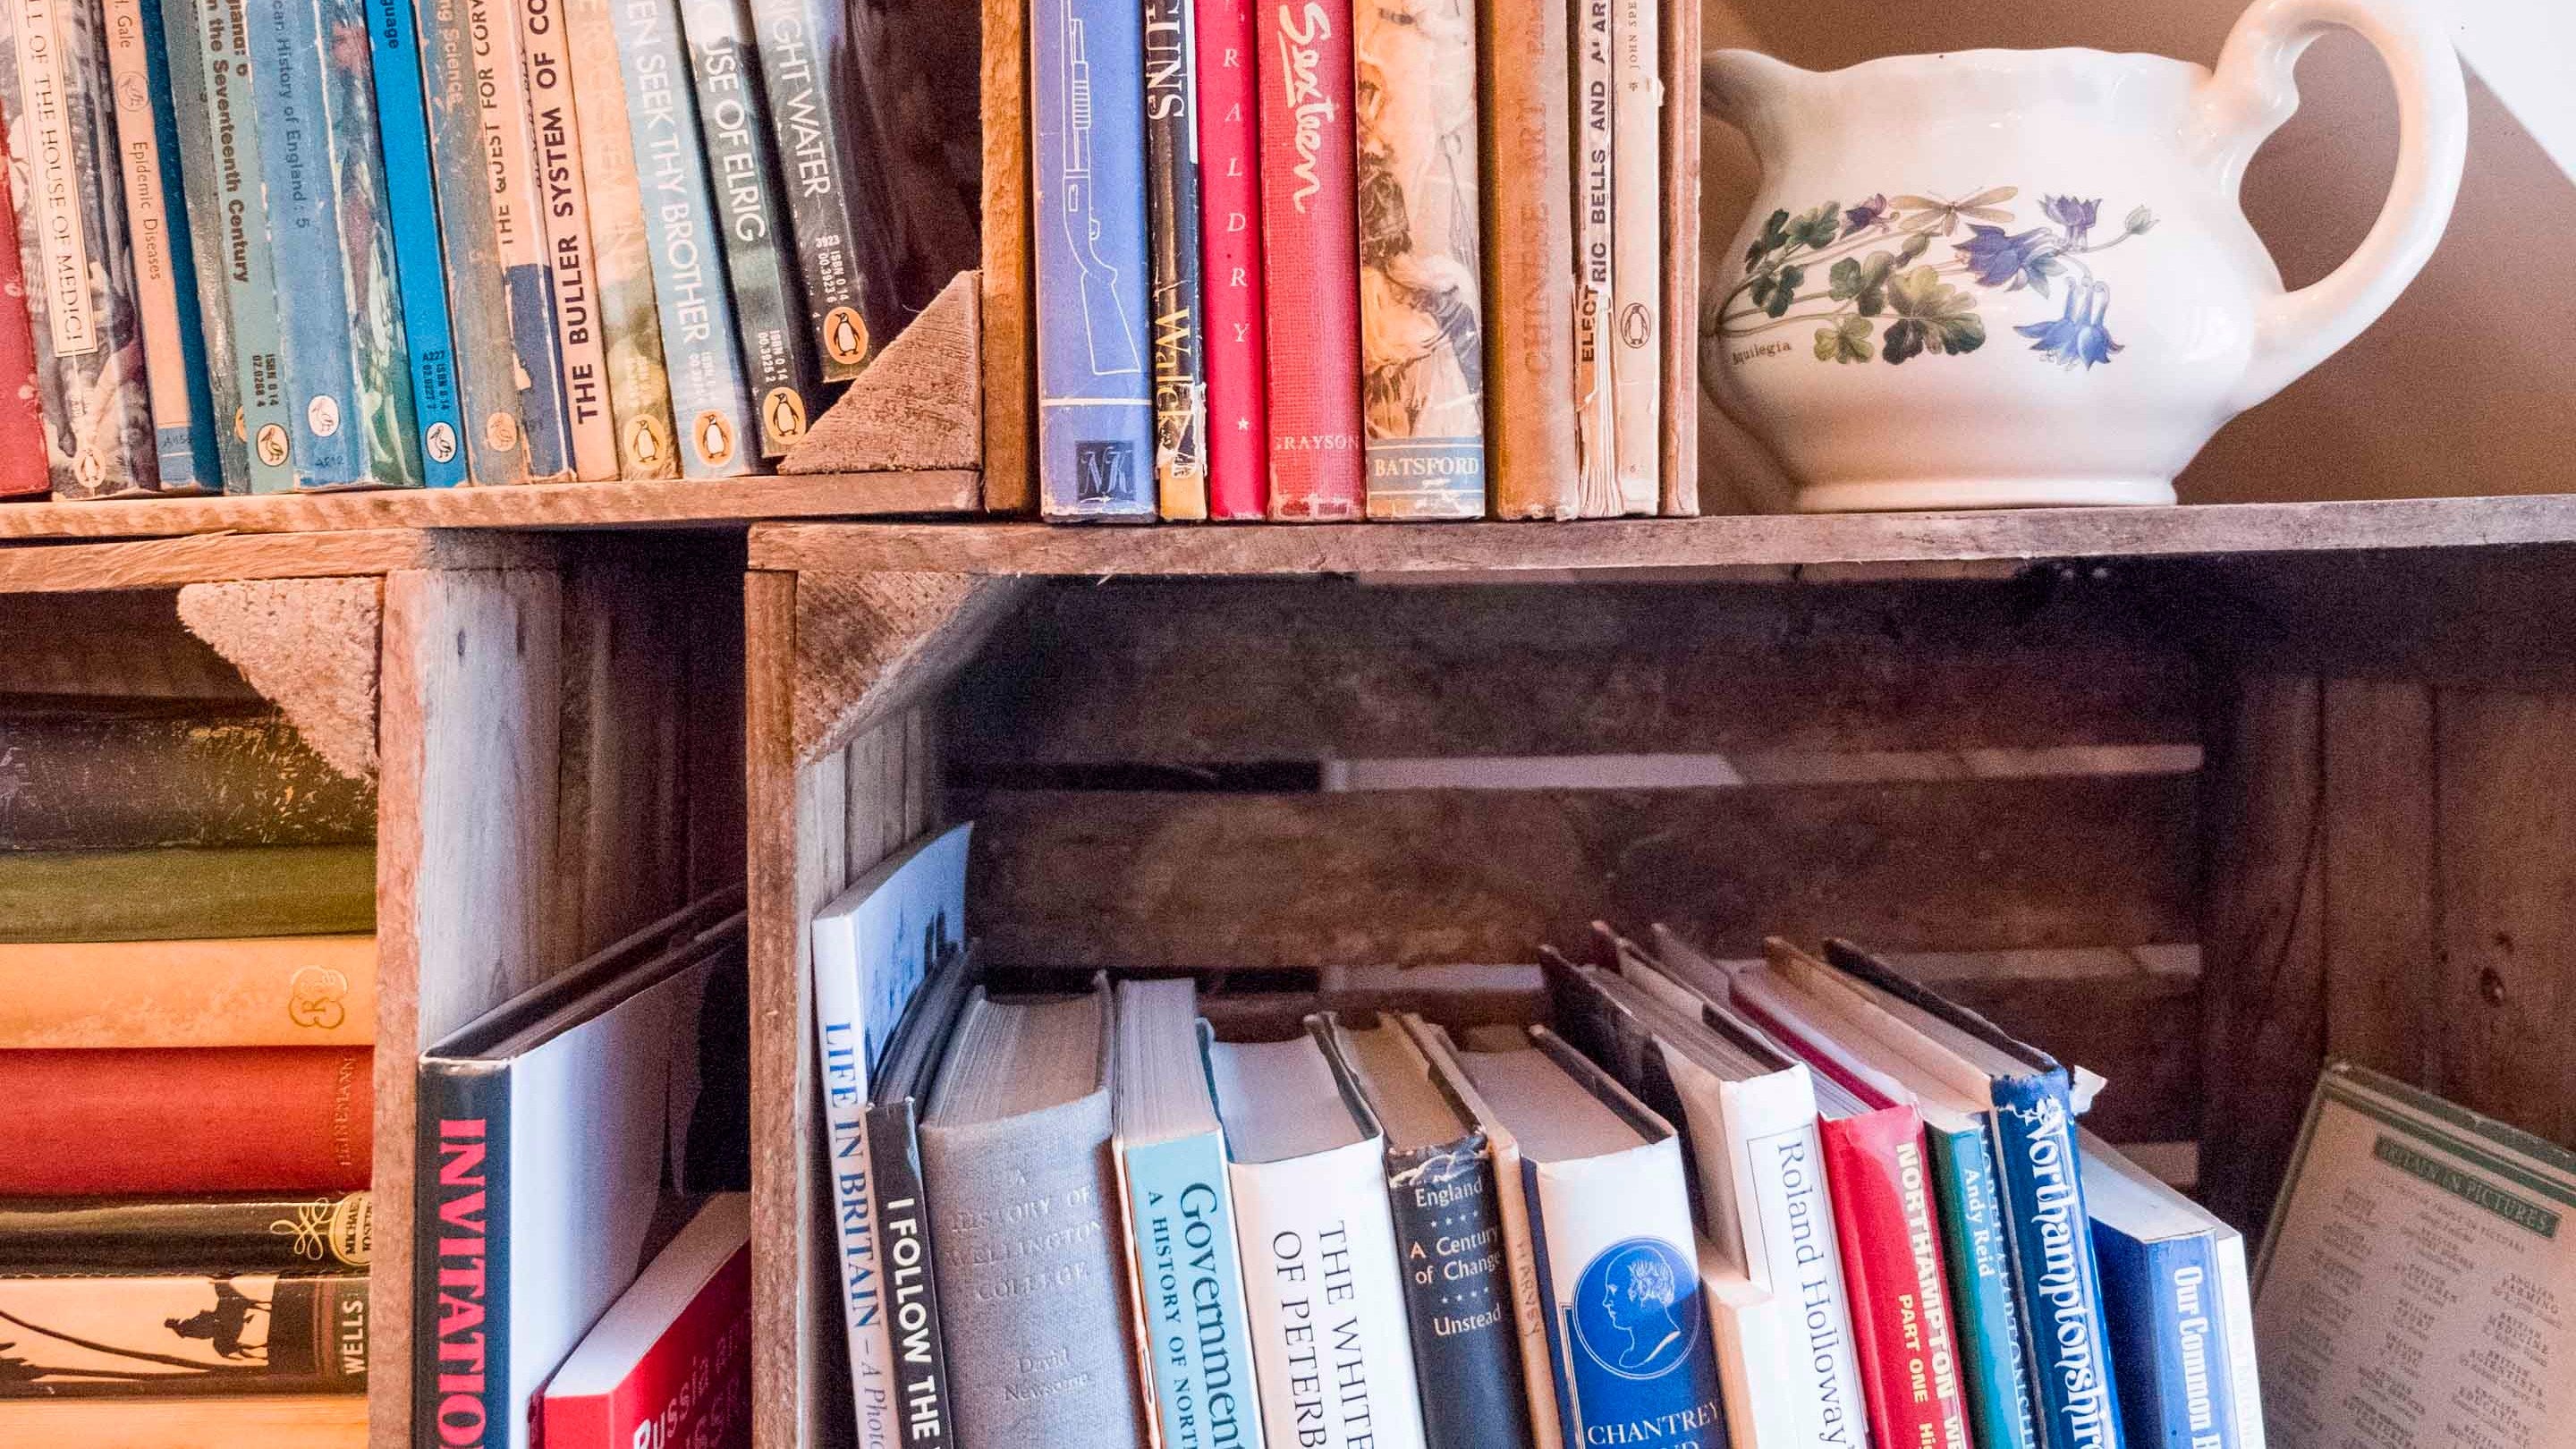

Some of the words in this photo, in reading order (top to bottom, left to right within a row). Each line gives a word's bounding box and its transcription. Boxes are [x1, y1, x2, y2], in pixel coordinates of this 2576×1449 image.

[30, 35, 47, 64] OF
[117, 14, 134, 48] Gale
[208, 18, 225, 52] the
[1629, 34, 1640, 70] JOHN
[275, 38, 292, 99] History
[284, 106, 300, 124] of
[442, 27, 464, 105] Science
[478, 67, 498, 109] FOR
[534, 52, 557, 89] OF
[636, 54, 676, 129] SEEK
[35, 78, 56, 123] THE
[213, 59, 242, 192] Seventeenth
[715, 98, 750, 147] OF
[1590, 80, 1606, 131] AND
[41, 129, 66, 208] HOUSE
[484, 122, 508, 194] QUEST
[541, 106, 573, 218] SYSTEM
[648, 133, 687, 193] THY
[787, 87, 831, 198] WATER
[130, 141, 152, 209] Epidemic
[143, 218, 161, 281] Diseases
[723, 152, 766, 242] ELRIG
[1591, 148, 1606, 225] BELLS
[52, 216, 72, 244] OF
[227, 199, 250, 282] Century
[56, 254, 82, 342] MEDICI
[557, 234, 589, 345] BULLER
[660, 202, 711, 344] BROTHER
[818, 252, 835, 293] 00.3923
[831, 250, 844, 276] ISBN
[838, 288, 850, 301] 14
[265, 353, 276, 379] ISBN
[436, 363, 447, 386] ISBN
[769, 329, 784, 355] ISBN
[777, 369, 789, 381] 14
[269, 394, 279, 406] 14
[572, 363, 598, 425] THE
[1374, 457, 1480, 478] BATSFORD
[826, 1022, 858, 1108] LIFE
[835, 1120, 864, 1158] IN
[887, 1198, 915, 1209] I
[1148, 1191, 1165, 1206] A
[1414, 1177, 1484, 1208] England
[1965, 1167, 1985, 1224] Andy
[2465, 1180, 2552, 1233] PICTURES
[839, 1172, 880, 1328] BRITAIN
[1272, 1230, 1307, 1283] OF
[1318, 1219, 1354, 1305] THE
[1410, 1241, 1428, 1259] A
[1436, 1224, 1500, 1256] Century
[1415, 1265, 1435, 1284] of
[1444, 1250, 1503, 1281] Change
[1974, 1228, 1996, 1279] Reid
[436, 1119, 487, 1449] INVITATIO
[888, 1217, 933, 1364] FOLLOW
[1152, 1216, 1182, 1324] HISTORY
[1777, 1140, 1825, 1268] Roland
[1801, 1275, 1847, 1445] Holloway
[1896, 1141, 1955, 1400] NORTHAMPTON
[2021, 1097, 2108, 1449] Northamptonshir
[2174, 1266, 2204, 1315] Our
[343, 1301, 366, 1376] WELLS
[1433, 1301, 1503, 1337] Unstead
[1898, 1293, 1921, 1352] PART
[861, 1361, 881, 1377] A
[1018, 1347, 1072, 1374] David
[1168, 1336, 1189, 1367] OF
[1281, 1296, 1327, 1449] PETERB
[2179, 1316, 2213, 1431] Common
[1909, 1358, 1928, 1403] ONE
[908, 1375, 941, 1441] THE
[1587, 1401, 1719, 1445] CHANTREY
[1918, 1422, 1938, 1449] Hi
